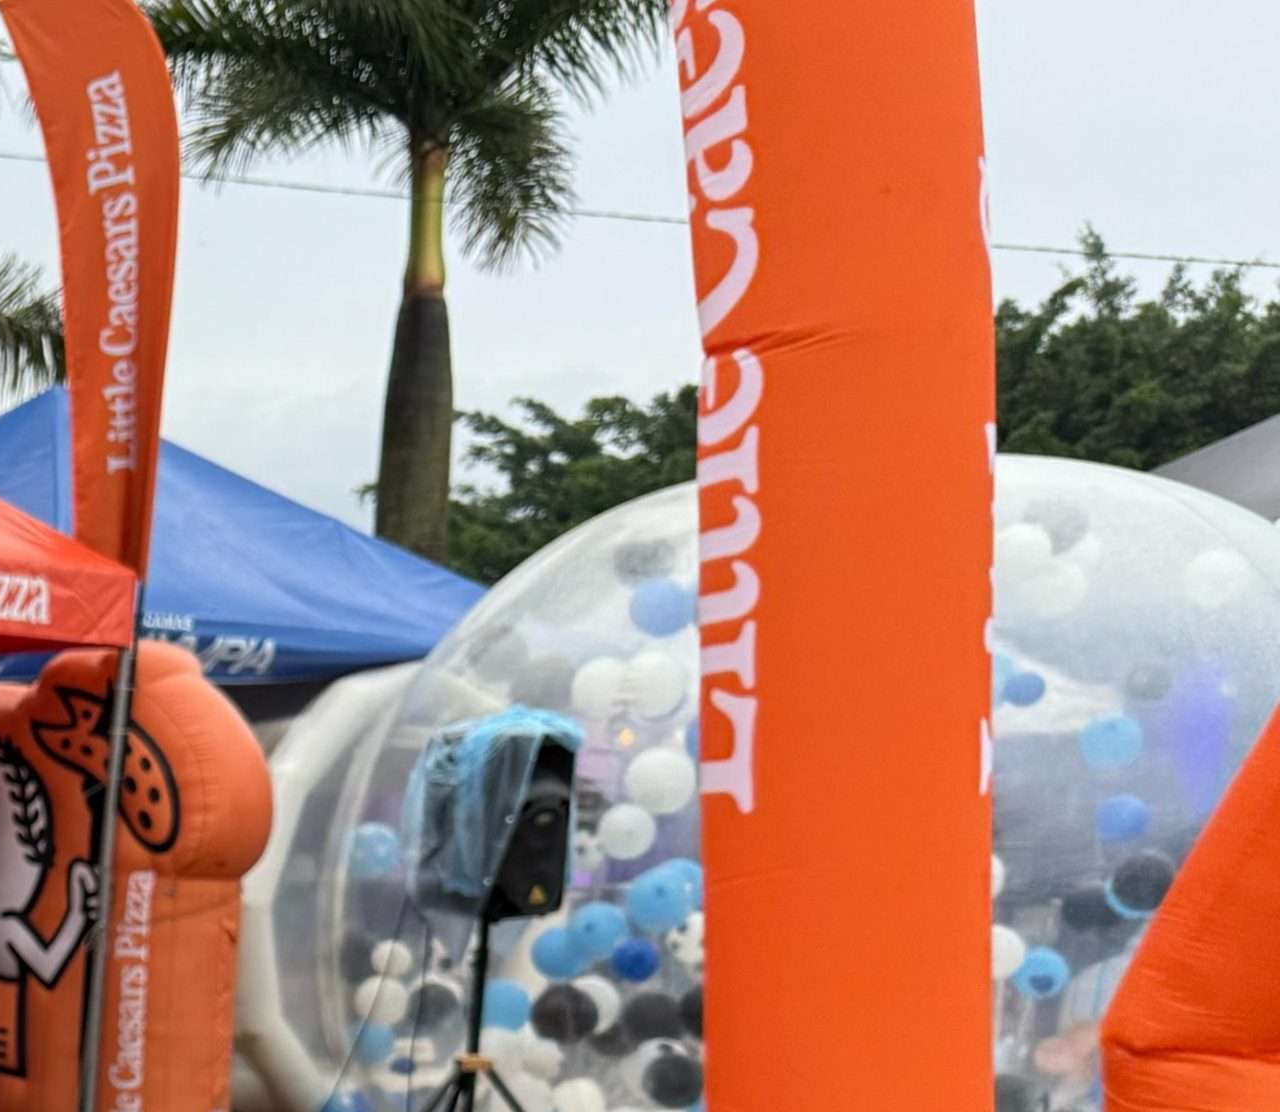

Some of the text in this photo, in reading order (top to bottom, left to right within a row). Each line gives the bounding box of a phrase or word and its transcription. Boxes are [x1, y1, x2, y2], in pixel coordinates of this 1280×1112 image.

[86, 70, 139, 476] Little Caesars Pizza
[114, 868, 157, 960] Pizza
[108, 963, 149, 1090] Caesars
